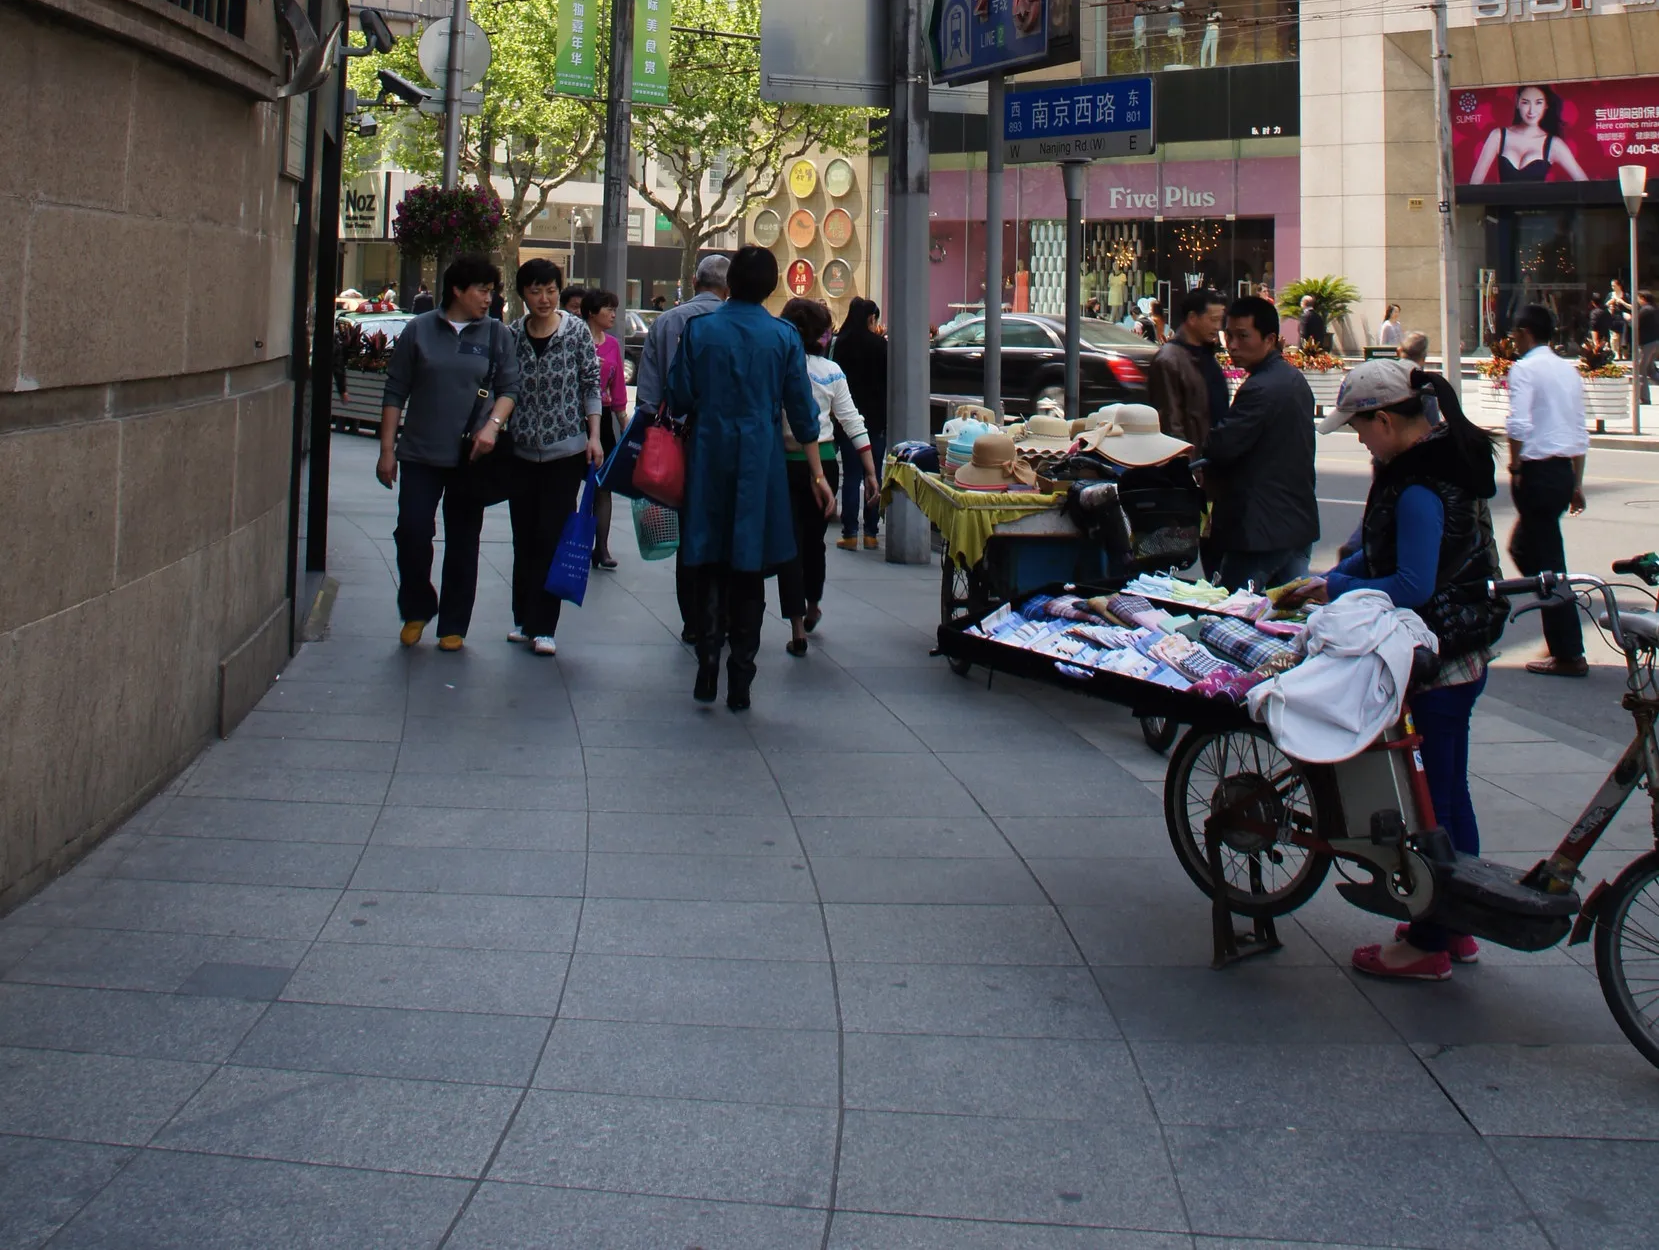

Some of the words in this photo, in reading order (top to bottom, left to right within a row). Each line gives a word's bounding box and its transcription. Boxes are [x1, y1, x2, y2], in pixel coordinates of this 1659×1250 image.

[980, 30, 995, 48] LINE
[1010, 101, 1021, 117] 西
[1032, 92, 1116, 129] 南京西路
[1128, 89, 1139, 107] 东
[1008, 122, 1023, 132] 893
[1126, 111, 1141, 122] 801
[1010, 145, 1021, 158] W
[1040, 141, 1071, 156] Nanjing
[1129, 135, 1137, 150] E
[1109, 187, 1157, 209] Five
[1165, 186, 1216, 207] Plus
